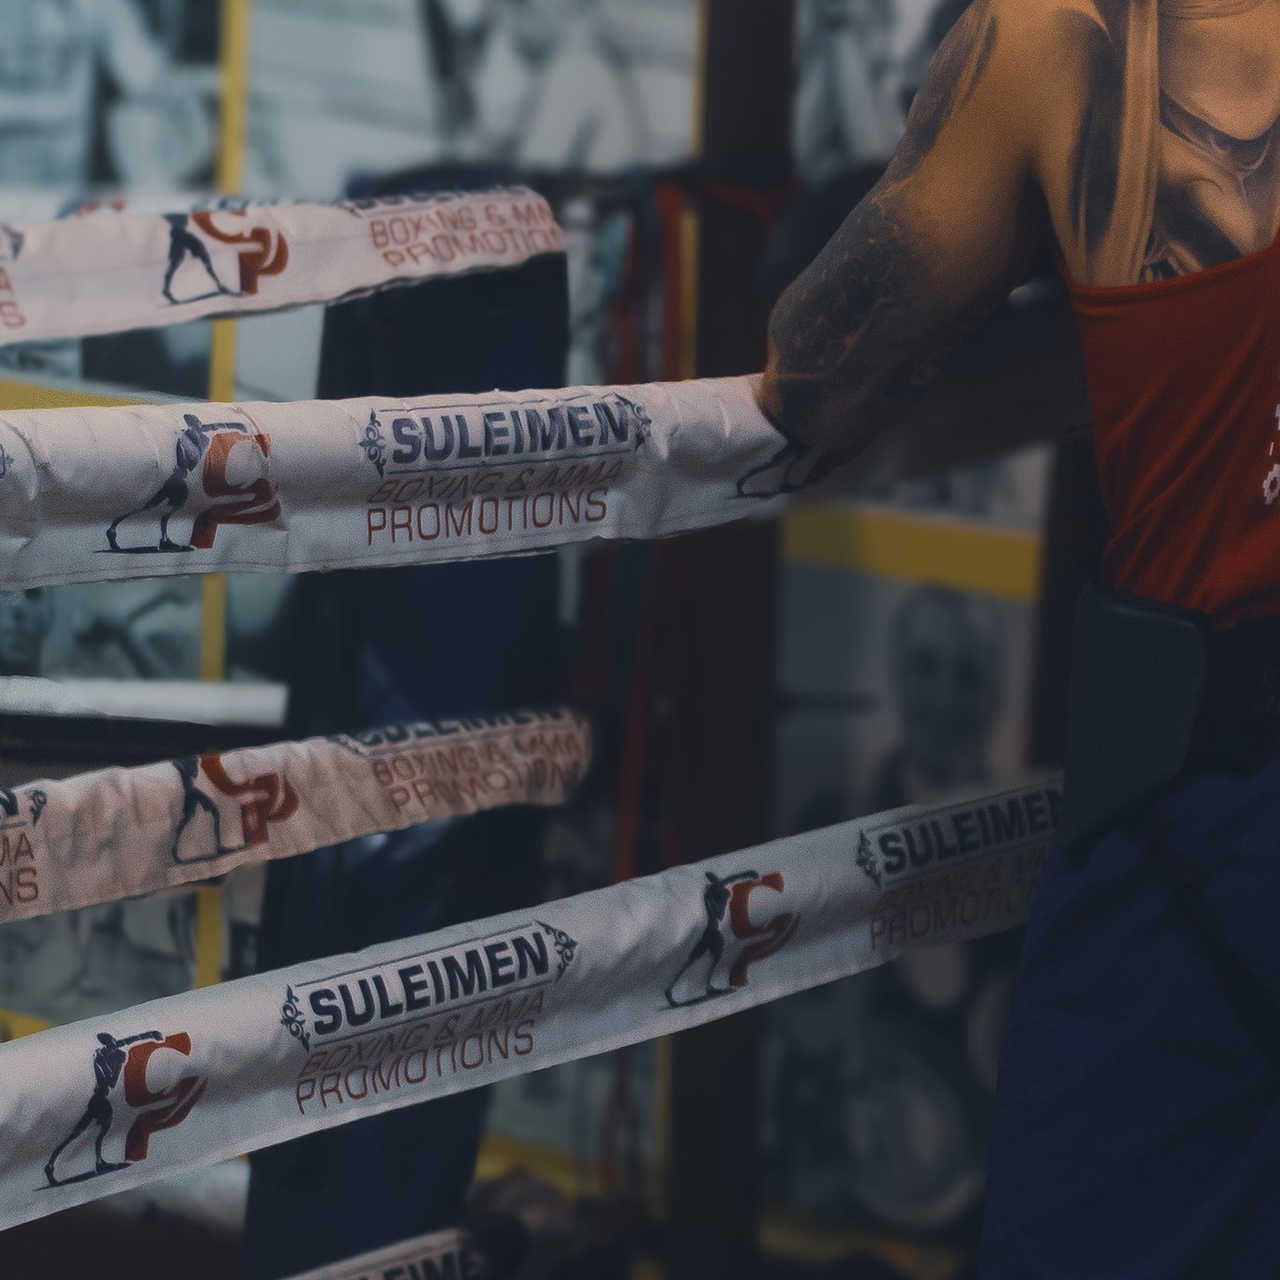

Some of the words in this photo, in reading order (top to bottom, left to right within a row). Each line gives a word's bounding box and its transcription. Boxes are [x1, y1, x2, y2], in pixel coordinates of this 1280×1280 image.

[391, 400, 630, 465] SULEIMEN
[367, 488, 608, 546] PROMOTIONS
[308, 931, 549, 1036] SULEIMEN
[295, 1019, 536, 1115] PROMOTIONS
